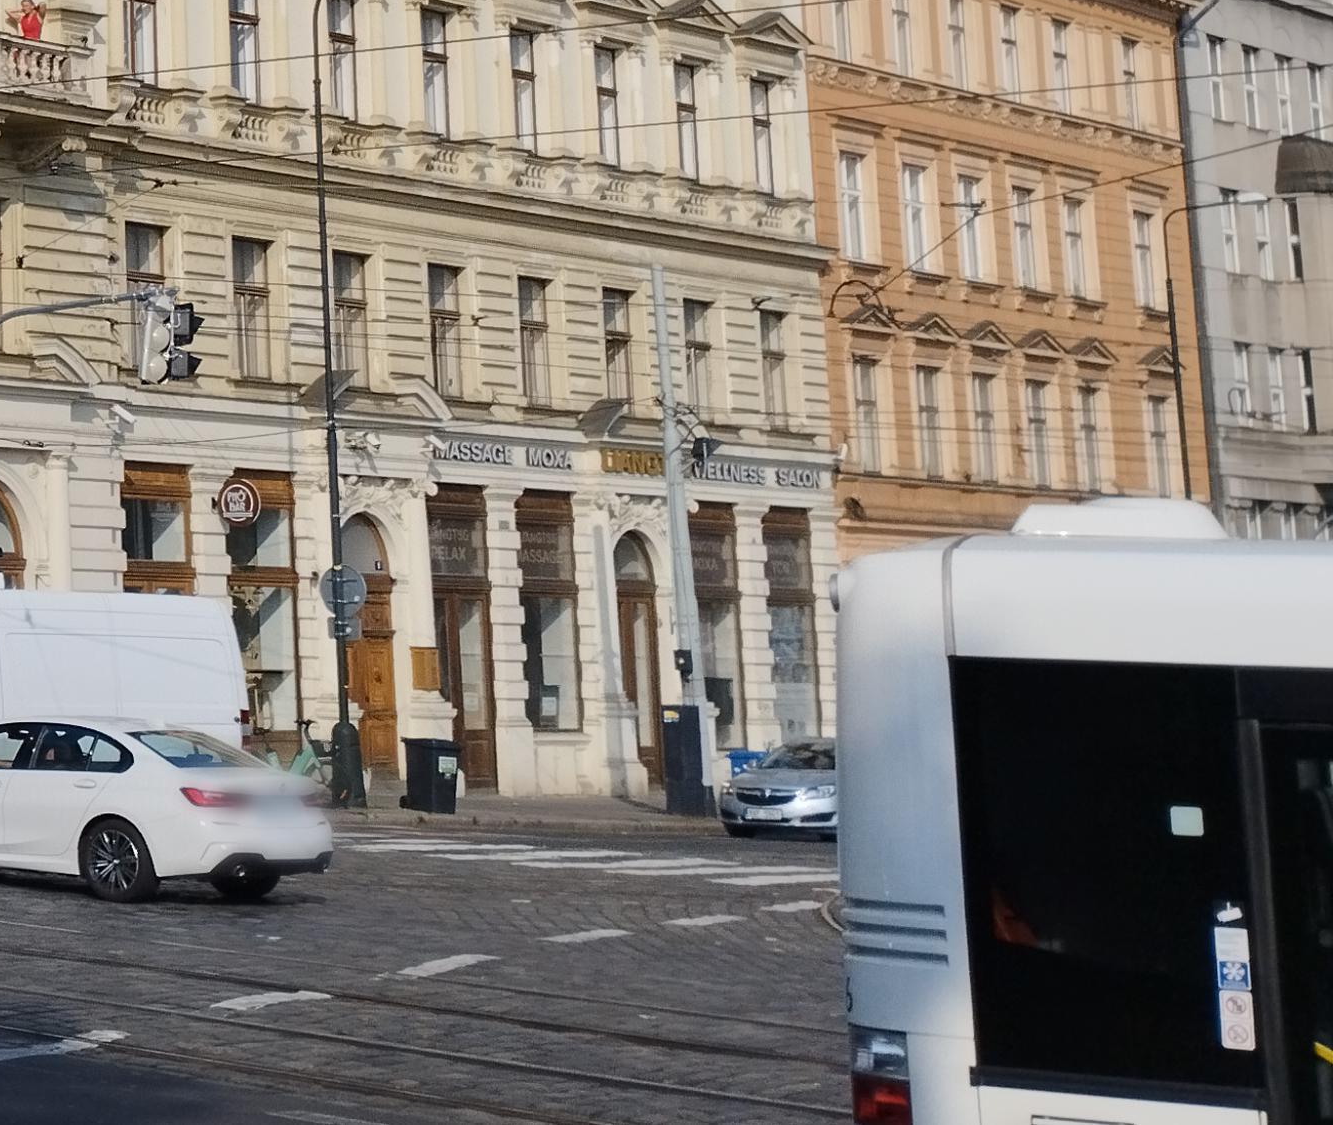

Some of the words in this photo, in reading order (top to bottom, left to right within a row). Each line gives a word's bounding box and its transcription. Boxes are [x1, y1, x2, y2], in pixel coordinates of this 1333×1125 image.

[435, 440, 514, 465] MASSAGE
[526, 448, 574, 471] MOXA
[778, 467, 821, 489] SALON
